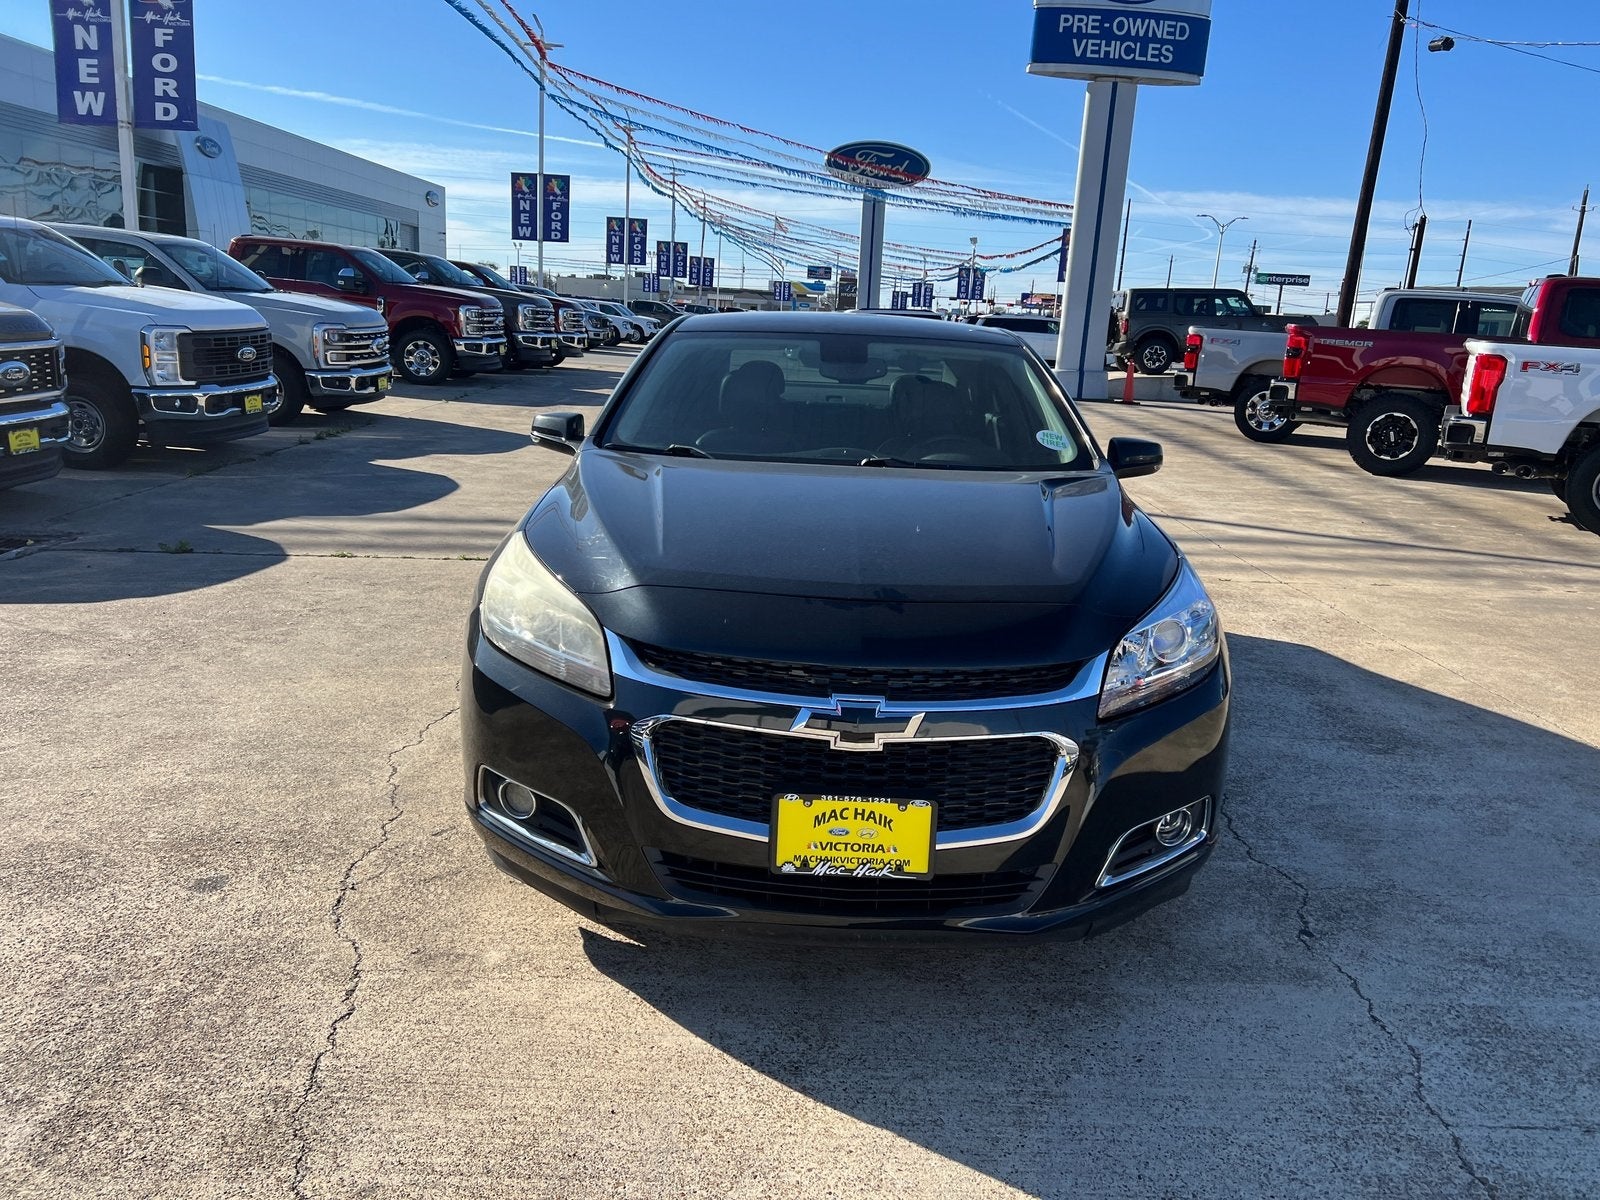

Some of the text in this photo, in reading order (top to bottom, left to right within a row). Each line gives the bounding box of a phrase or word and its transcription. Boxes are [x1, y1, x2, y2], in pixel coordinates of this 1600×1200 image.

[1059, 14, 1190, 41] PRE-OWNED
[1072, 39, 1174, 64] VEHICLES
[73, 24, 105, 117] NEW
[151, 27, 180, 121] FORD
[849, 149, 910, 176] Ford
[518, 199, 531, 237] NEW
[551, 202, 562, 239] FORD
[610, 235, 620, 262] NEW
[633, 236, 641, 264] FORD
[959, 280, 967, 298] NEW
[1259, 274, 1310, 285] enterprise
[1210, 337, 1241, 346] FX4
[1319, 338, 1374, 347] TREMOR
[6, 368, 25, 379] Ford
[1520, 361, 1581, 374] FX4
[1040, 437, 1067, 449] TIRES
[1042, 431, 1063, 441] NEW
[813, 807, 894, 832] MAC HAIK
[818, 841, 886, 854] VICTORIA
[812, 861, 895, 878] Mac Haik
